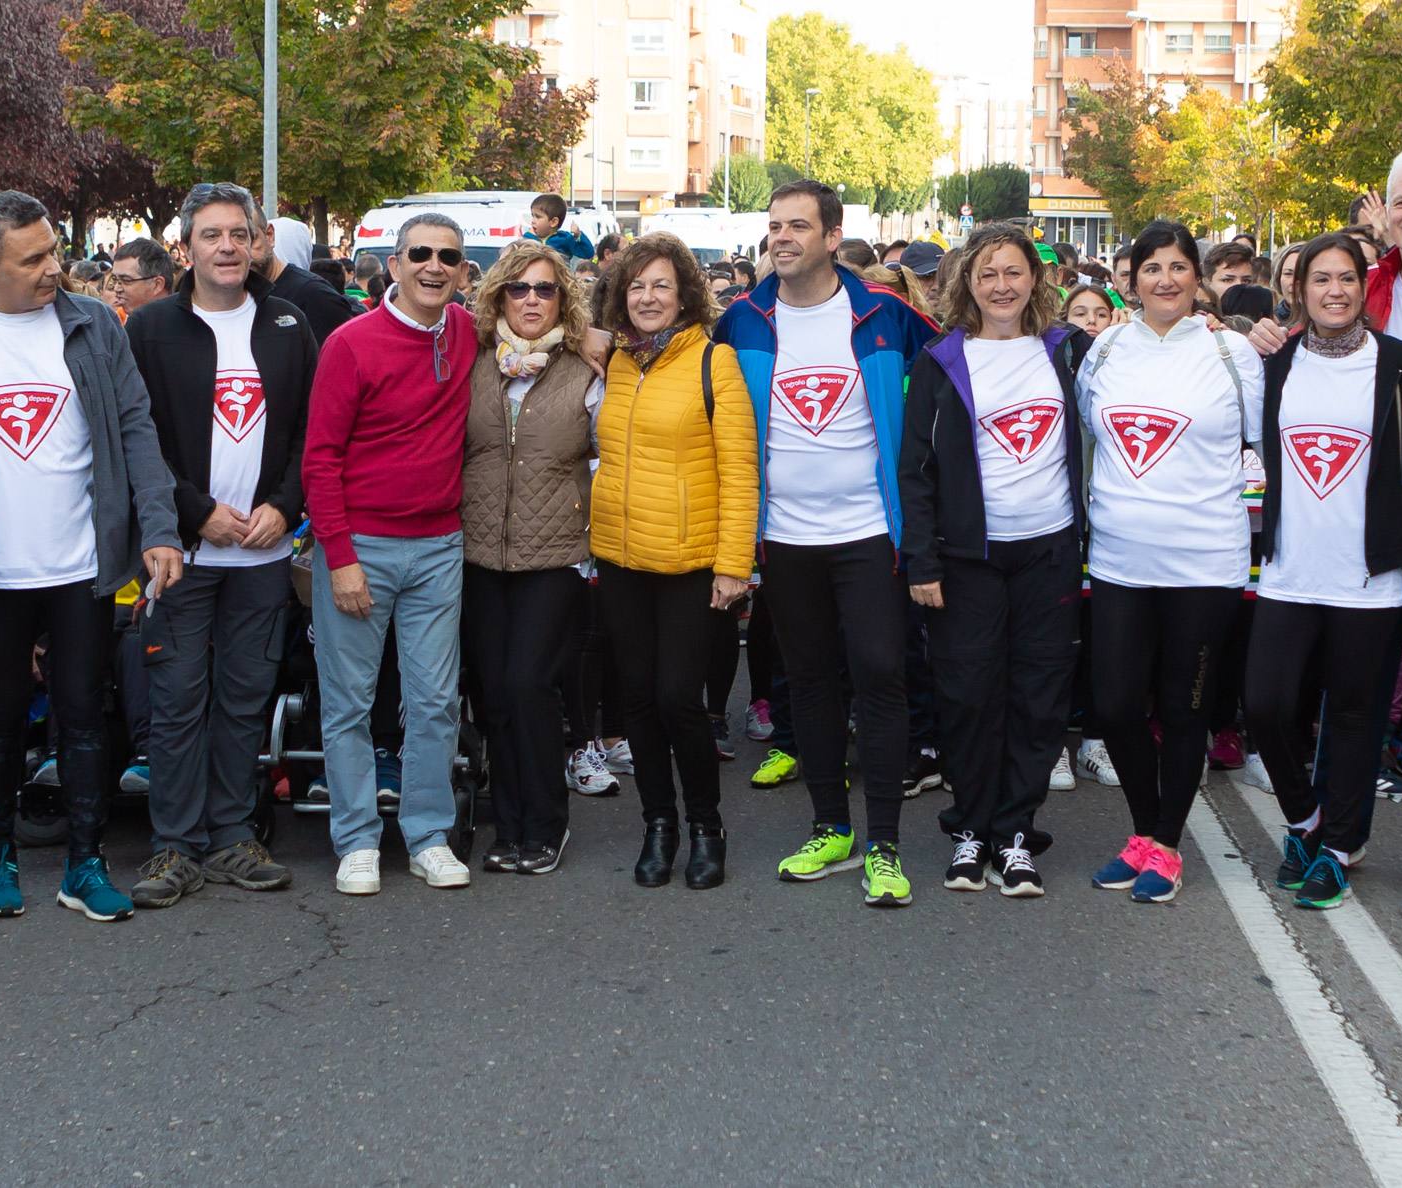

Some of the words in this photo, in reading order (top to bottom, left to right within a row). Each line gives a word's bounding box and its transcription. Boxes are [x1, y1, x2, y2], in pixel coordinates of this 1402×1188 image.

[1048, 200, 1108, 210] DONHIL
[820, 377, 845, 385] deporte
[29, 395, 54, 403] deporte
